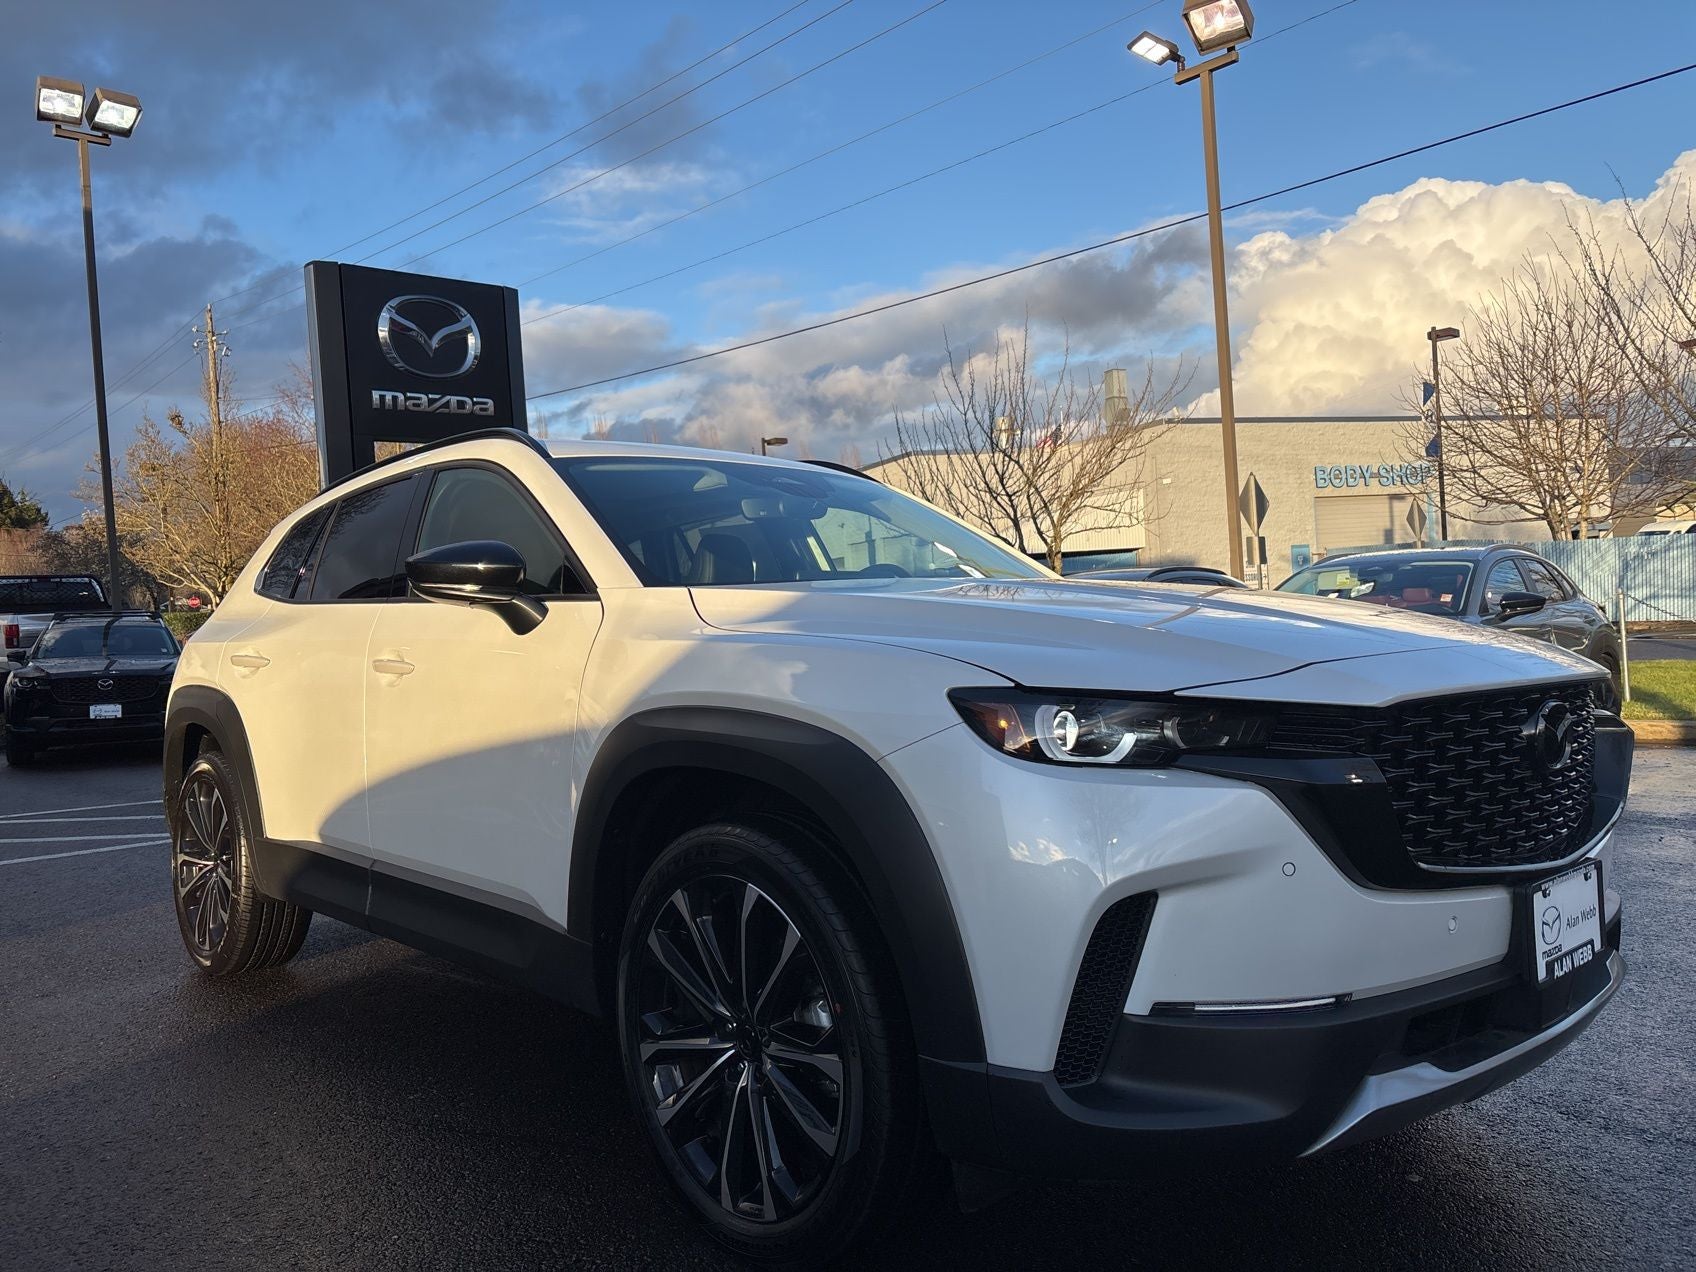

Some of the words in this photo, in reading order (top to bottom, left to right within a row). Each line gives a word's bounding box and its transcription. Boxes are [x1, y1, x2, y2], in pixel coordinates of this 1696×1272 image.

[371, 390, 494, 416] mazda
[1314, 464, 1372, 488] BODY
[1378, 463, 1431, 487] SHOP
[1565, 914, 1580, 931] Alan
[1580, 903, 1596, 921] Webb
[1554, 952, 1572, 979] ALAN
[1572, 944, 1592, 968] WEBB
